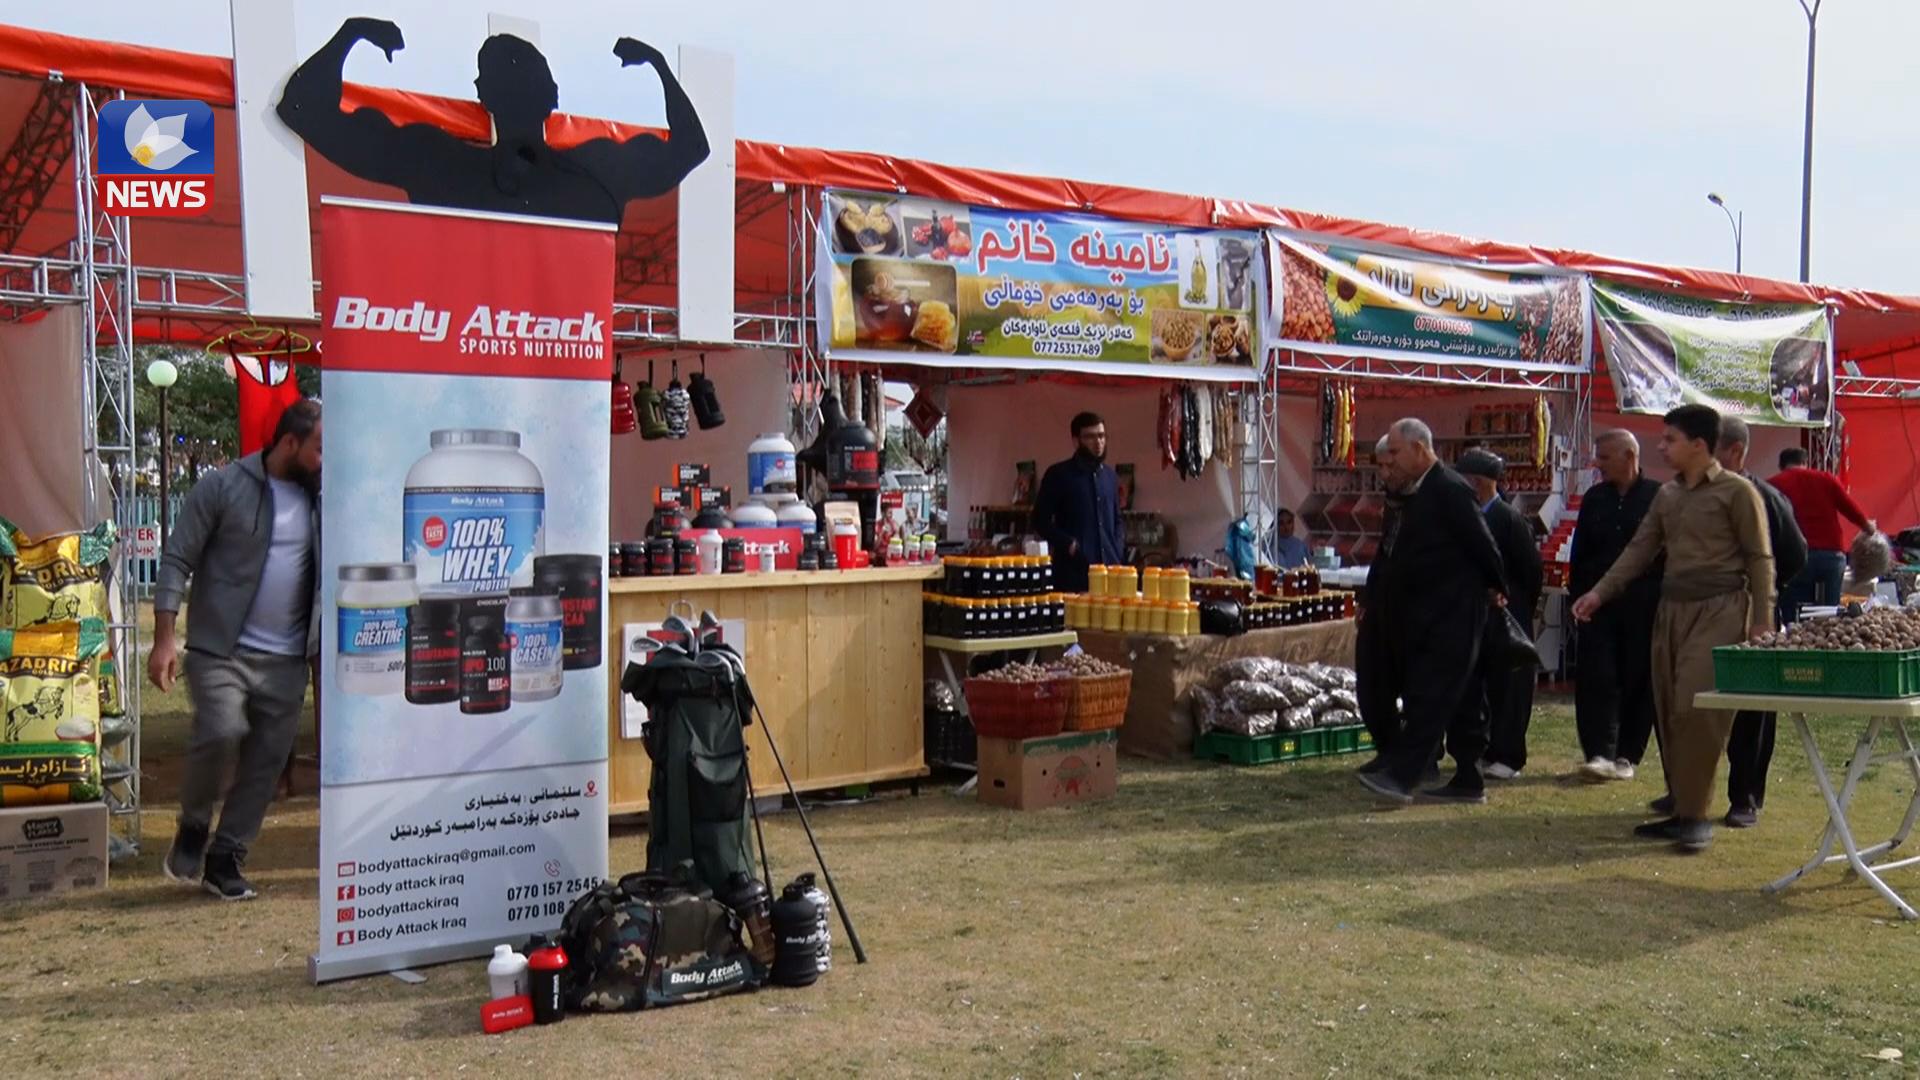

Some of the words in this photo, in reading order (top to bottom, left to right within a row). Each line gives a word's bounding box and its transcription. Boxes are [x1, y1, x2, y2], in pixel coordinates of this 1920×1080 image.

[978, 218, 1056, 273] خانم
[332, 297, 451, 342] Body
[460, 305, 605, 343] Attack
[459, 337, 517, 356] SPORTS
[524, 341, 604, 360] NUTRITION
[1033, 341, 1101, 356] 07725317489
[451, 517, 505, 547] 100%
[442, 546, 512, 583] WHEY
[474, 580, 509, 593] PROTEIN
[353, 628, 405, 647] CREATINE
[523, 633, 547, 649] 100%
[487, 656, 506, 672] 100
[515, 647, 554, 664] CASEIN
[358, 843, 536, 875] bodyattackiraq@gmail.com
[358, 881, 393, 898] body
[395, 875, 437, 893] attack
[439, 873, 465, 890] iraq
[507, 885, 539, 902] 0770
[542, 880, 564, 897] 157
[566, 878, 599, 894] 2545
[358, 894, 460, 920] bodyattackiraq
[507, 905, 540, 922] 0770
[542, 901, 566, 918] 108
[357, 926, 393, 943] Body
[395, 919, 439, 937] Attack
[440, 915, 468, 931] Iraq
[670, 970, 706, 985] Body
[706, 960, 743, 980] Attack
